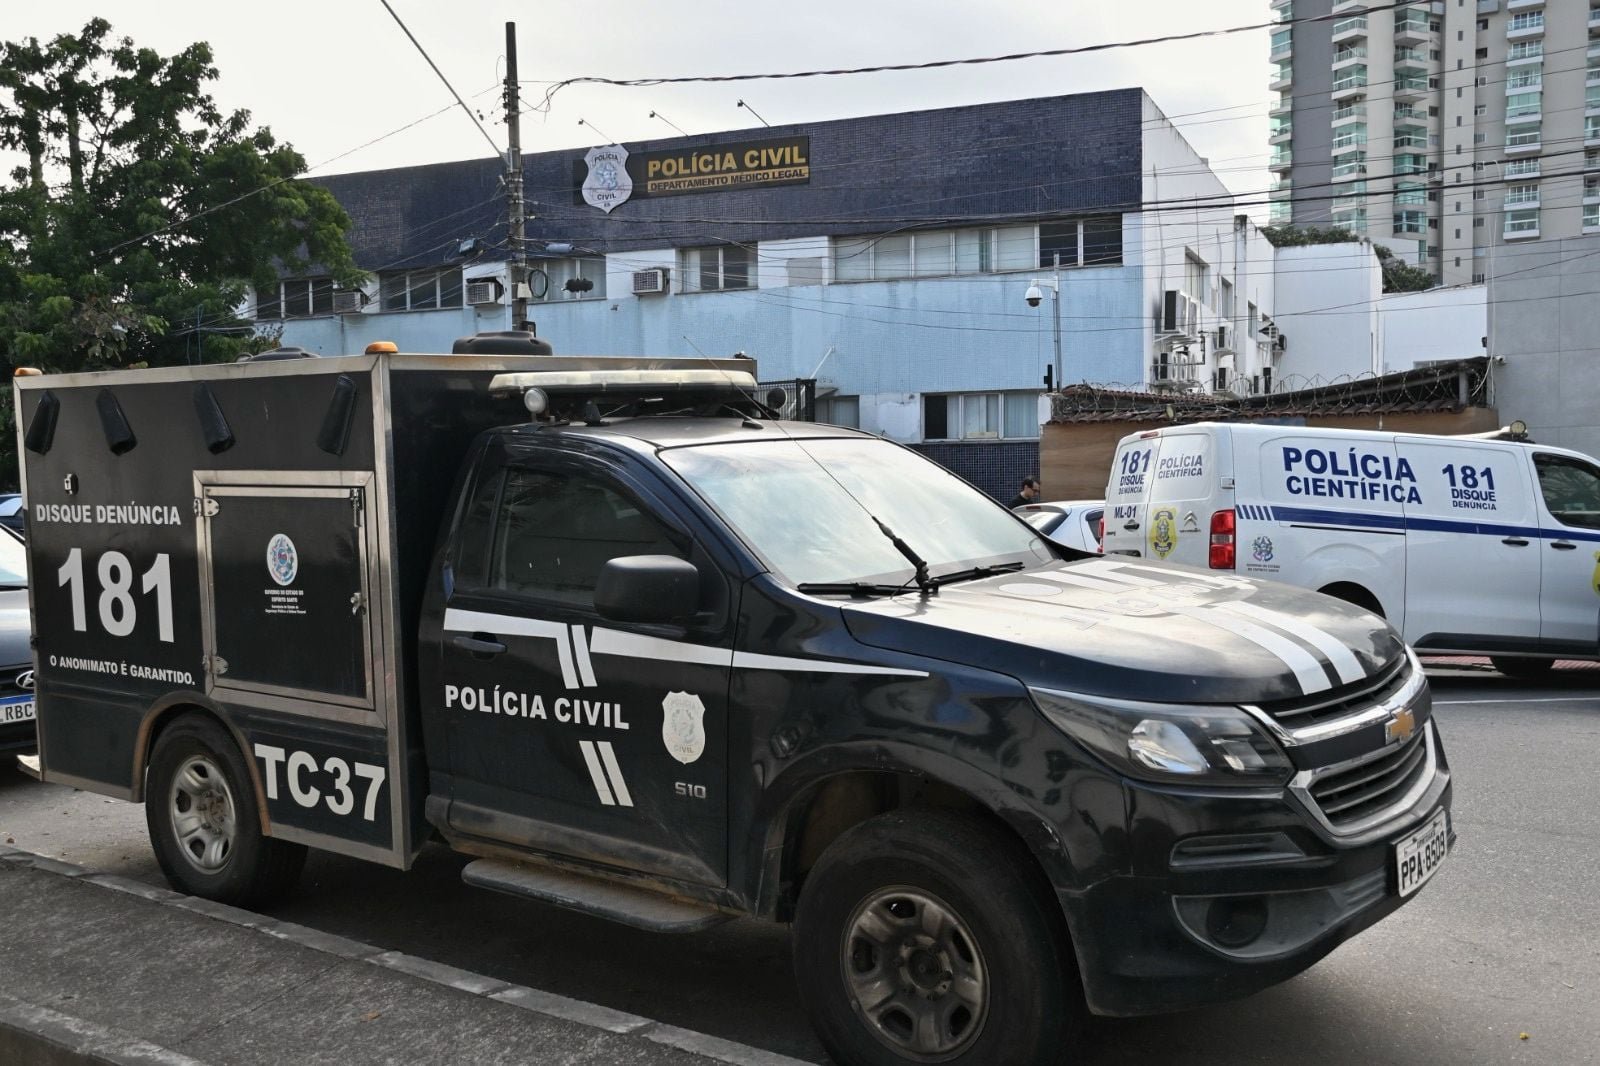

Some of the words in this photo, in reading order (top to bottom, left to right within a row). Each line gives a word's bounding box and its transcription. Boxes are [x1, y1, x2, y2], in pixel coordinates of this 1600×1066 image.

[648, 152, 737, 177] POLÍCIA
[744, 146, 806, 168] CIVIL
[650, 176, 728, 191] DEPARTAMENTO
[730, 172, 769, 184] MÉDICO
[772, 168, 805, 180] LEGAL
[1121, 449, 1152, 475] 181
[1158, 468, 1203, 479] CIENTÍFICA
[1159, 453, 1203, 470] POLÍCIA
[1282, 447, 1417, 483] POLÍCIA
[1120, 474, 1145, 486] DISQUE
[1442, 464, 1495, 490] 181
[1286, 476, 1423, 505] CIENTÍFICA
[1451, 488, 1497, 502] DISQUE
[36, 504, 92, 523] DISQUE
[96, 501, 181, 526] DENÚNCIA
[1114, 506, 1137, 519] ML-01
[1452, 500, 1497, 511] DENÚNCIA
[58, 547, 174, 643] 181
[50, 655, 57, 666] O
[120, 661, 128, 676] É
[130, 664, 196, 686] GARANTIDO.
[445, 684, 547, 720] POLÍCIA
[554, 697, 630, 730] CIVIL
[254, 743, 386, 822] TC37
[674, 781, 706, 799] S10
